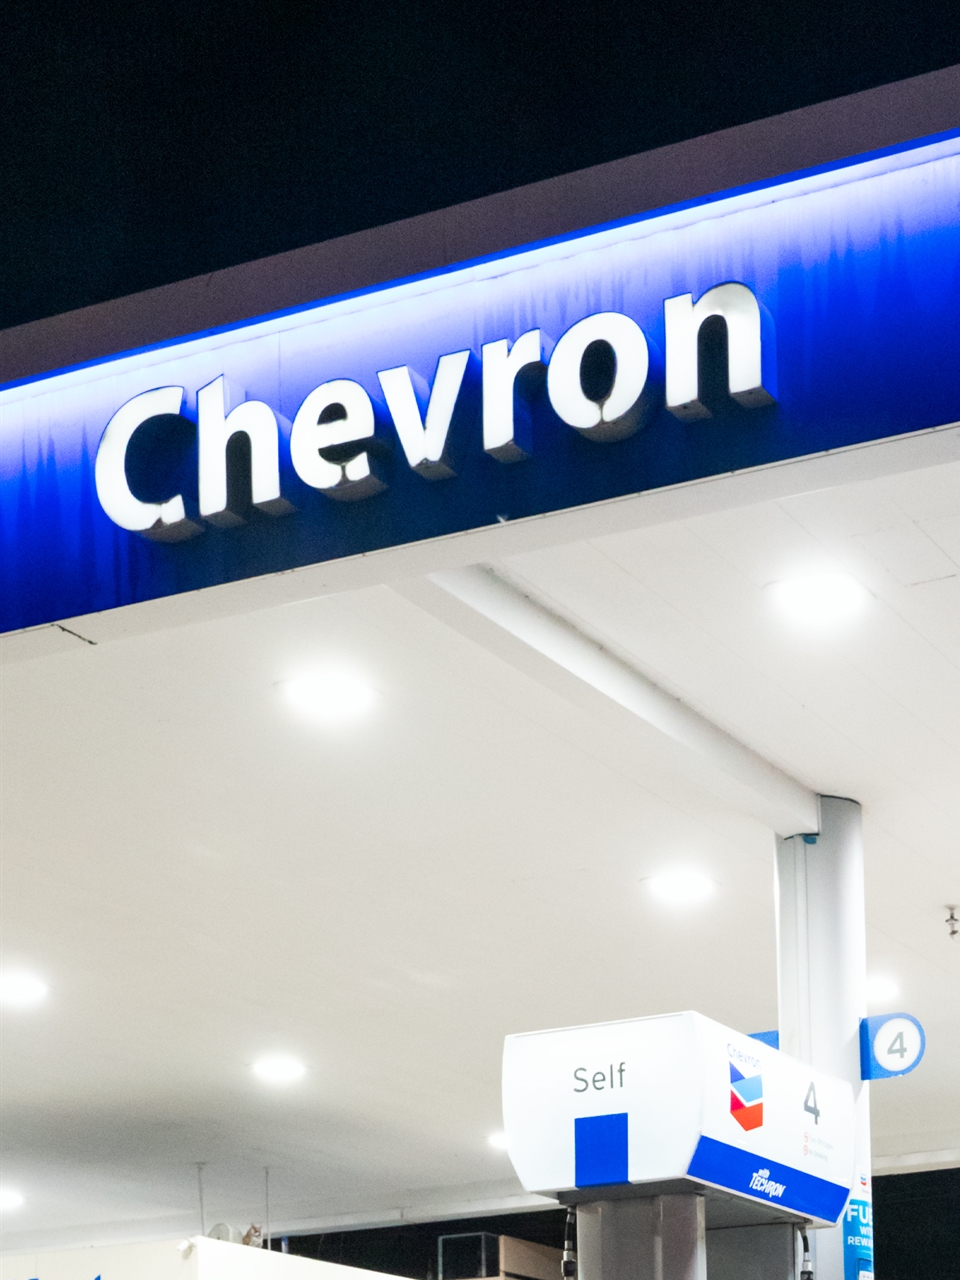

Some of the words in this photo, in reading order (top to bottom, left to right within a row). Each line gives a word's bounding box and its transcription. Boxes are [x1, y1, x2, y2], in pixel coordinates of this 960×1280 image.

[95, 281, 763, 533] Chevron
[727, 1043, 761, 1070] Chevron
[887, 1031, 907, 1059] 4
[573, 1061, 626, 1093] Self
[803, 1081, 820, 1125] 4
[749, 1172, 786, 1198] TECHRON
